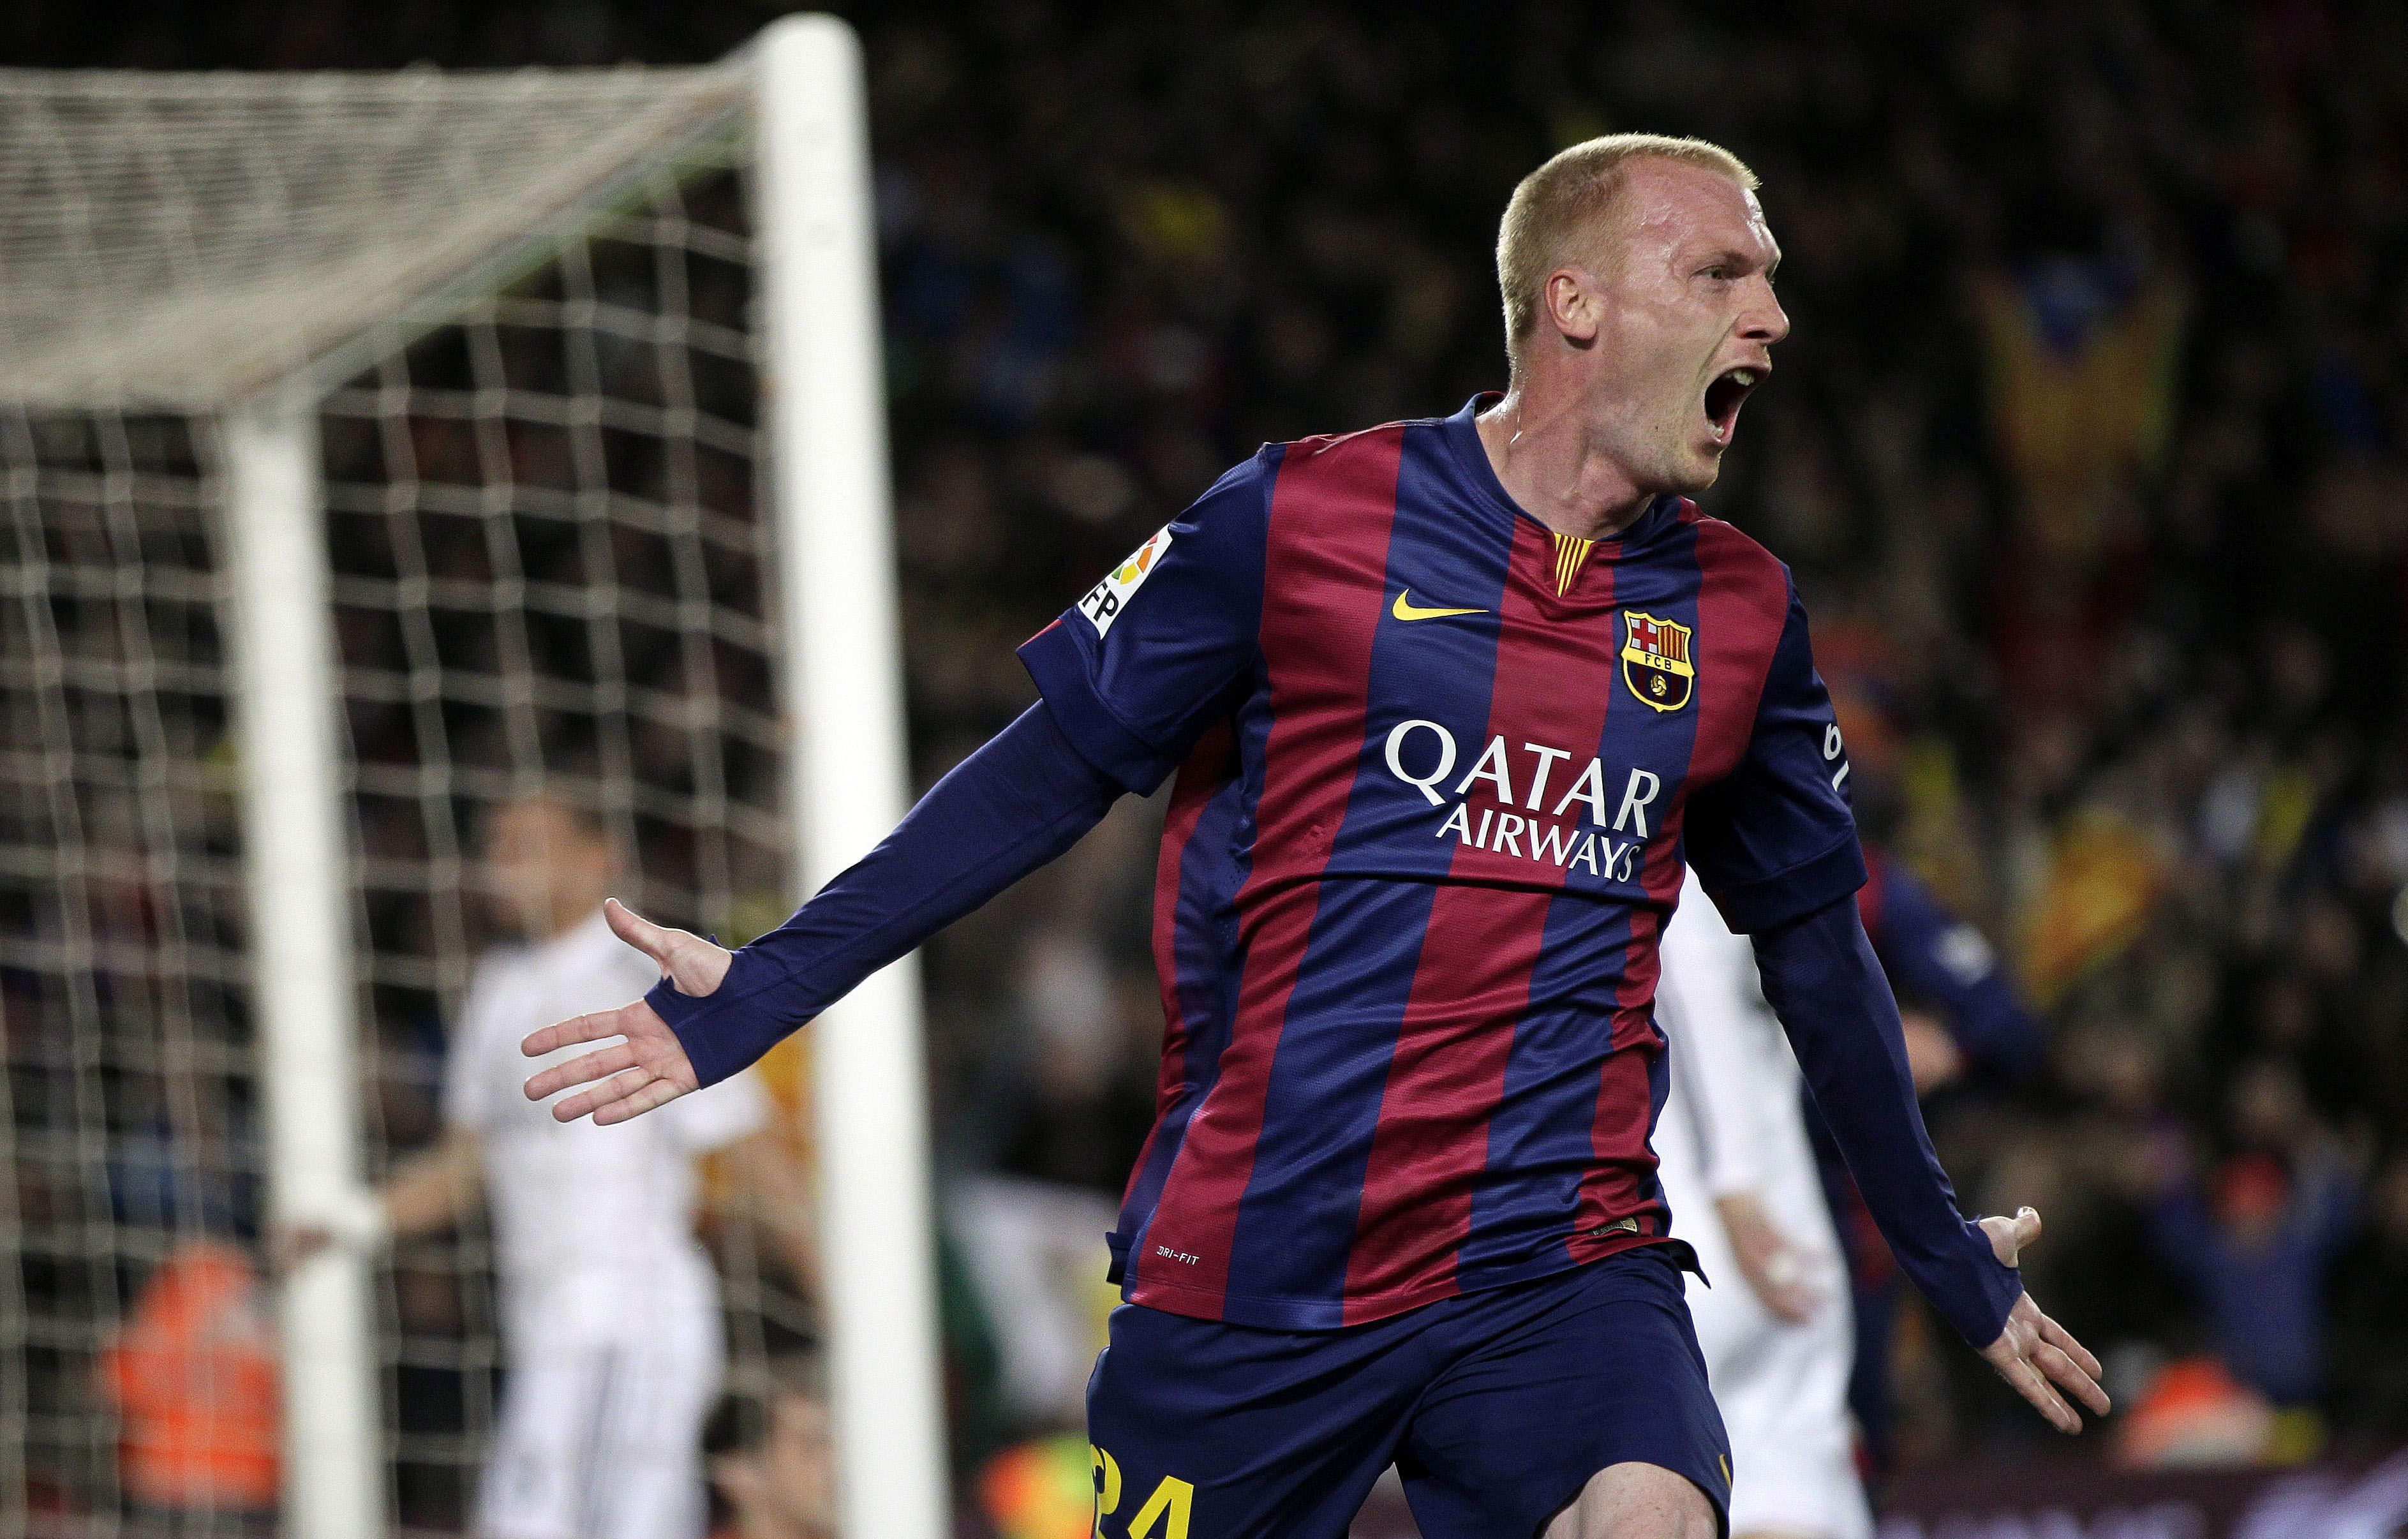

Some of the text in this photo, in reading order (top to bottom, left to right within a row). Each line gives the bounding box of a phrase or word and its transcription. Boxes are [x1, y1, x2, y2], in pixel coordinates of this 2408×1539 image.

[1645, 653, 1672, 670] FCB
[1385, 719, 1660, 838] QATAR
[1435, 803, 1640, 882] AIRWAYS
[1157, 1245, 1200, 1265] DRI-FIT
